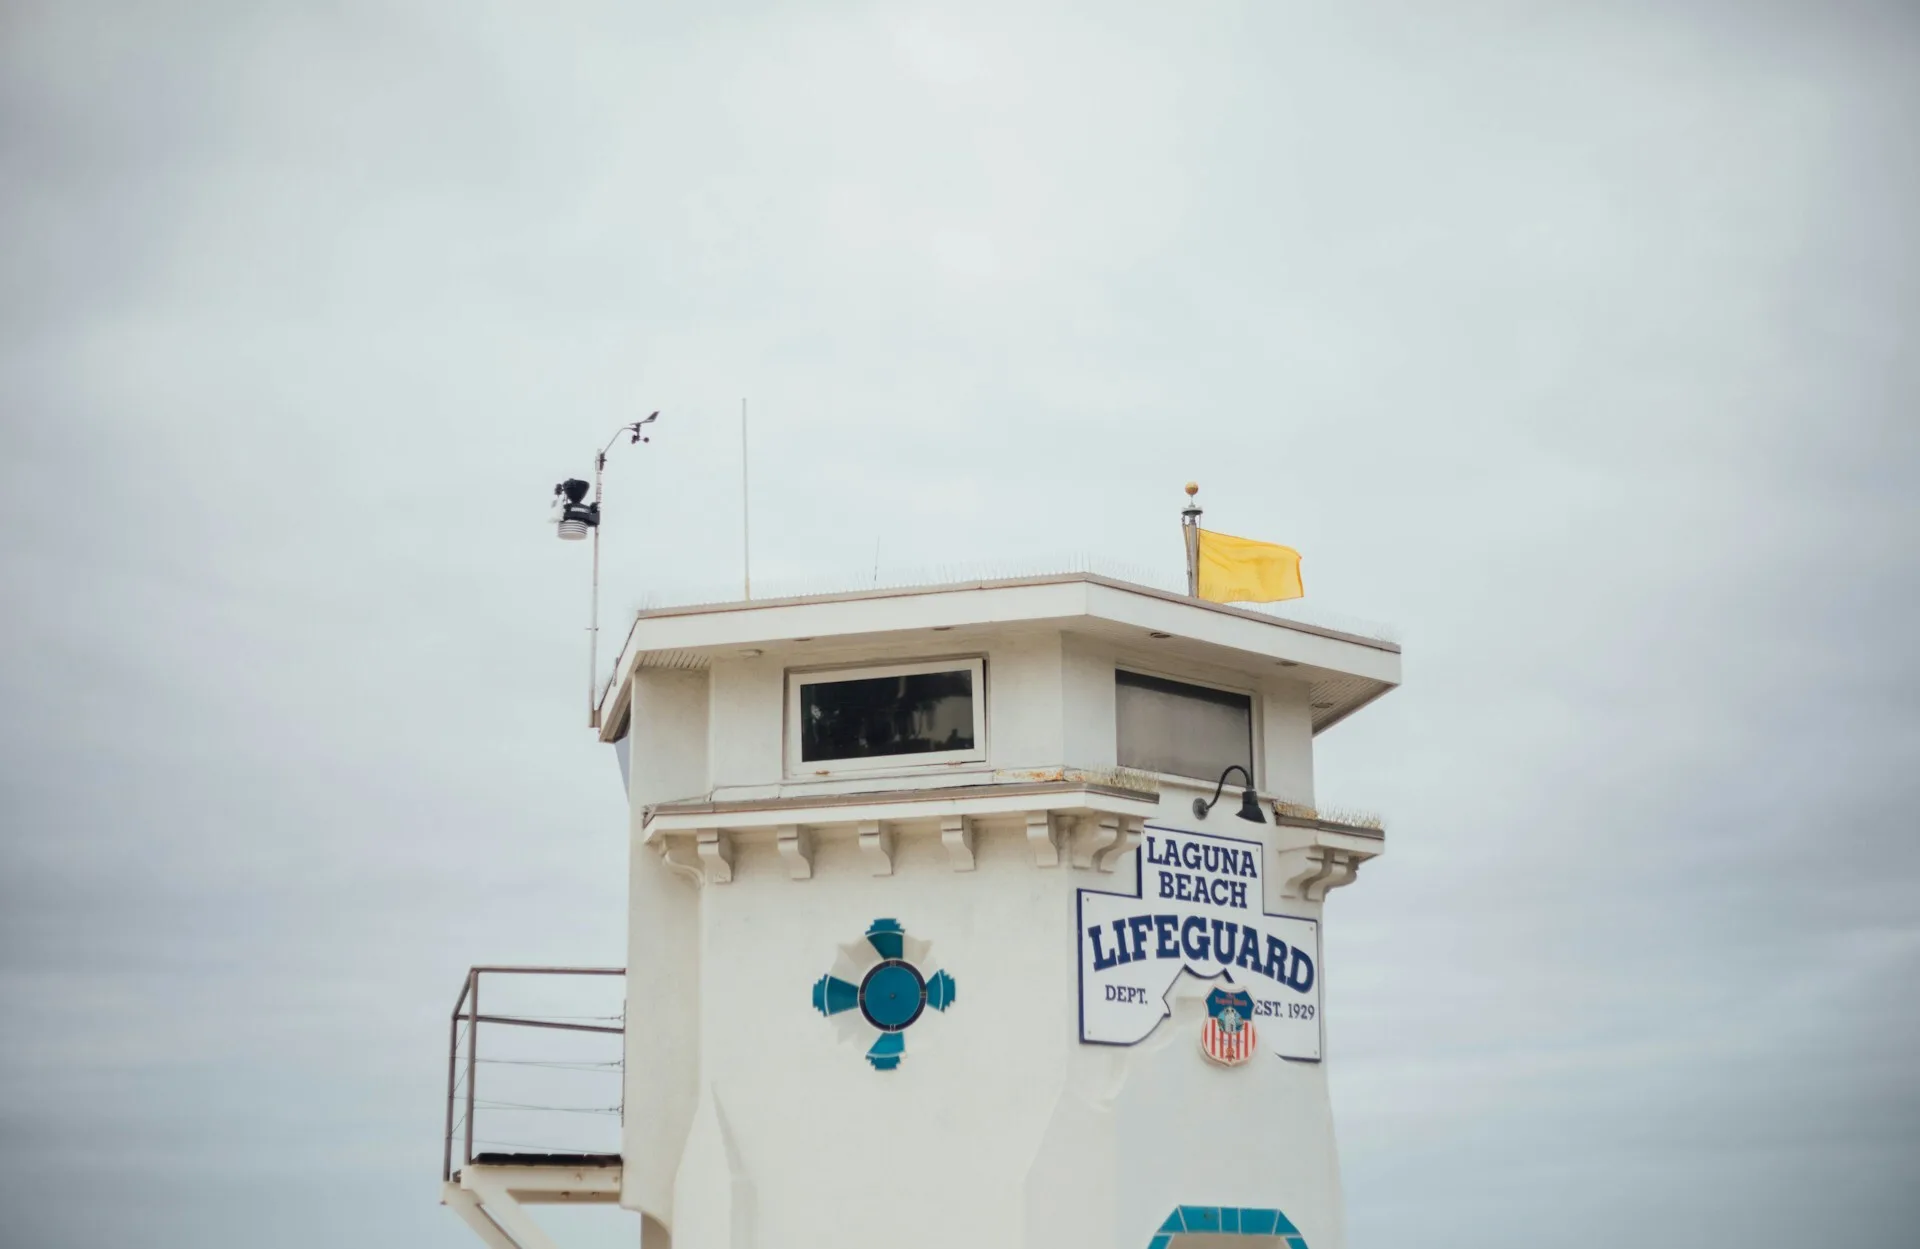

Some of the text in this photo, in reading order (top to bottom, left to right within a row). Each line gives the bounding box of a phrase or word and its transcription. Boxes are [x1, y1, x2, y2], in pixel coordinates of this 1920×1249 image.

[1146, 836, 1257, 878] LAGUNA
[1158, 871, 1248, 908] BEACH
[1087, 914, 1314, 994] LIFEGUARD
[1105, 984, 1148, 1004] DEPT.
[1254, 1000, 1283, 1018] EST.
[1288, 1003, 1315, 1020] 1929
